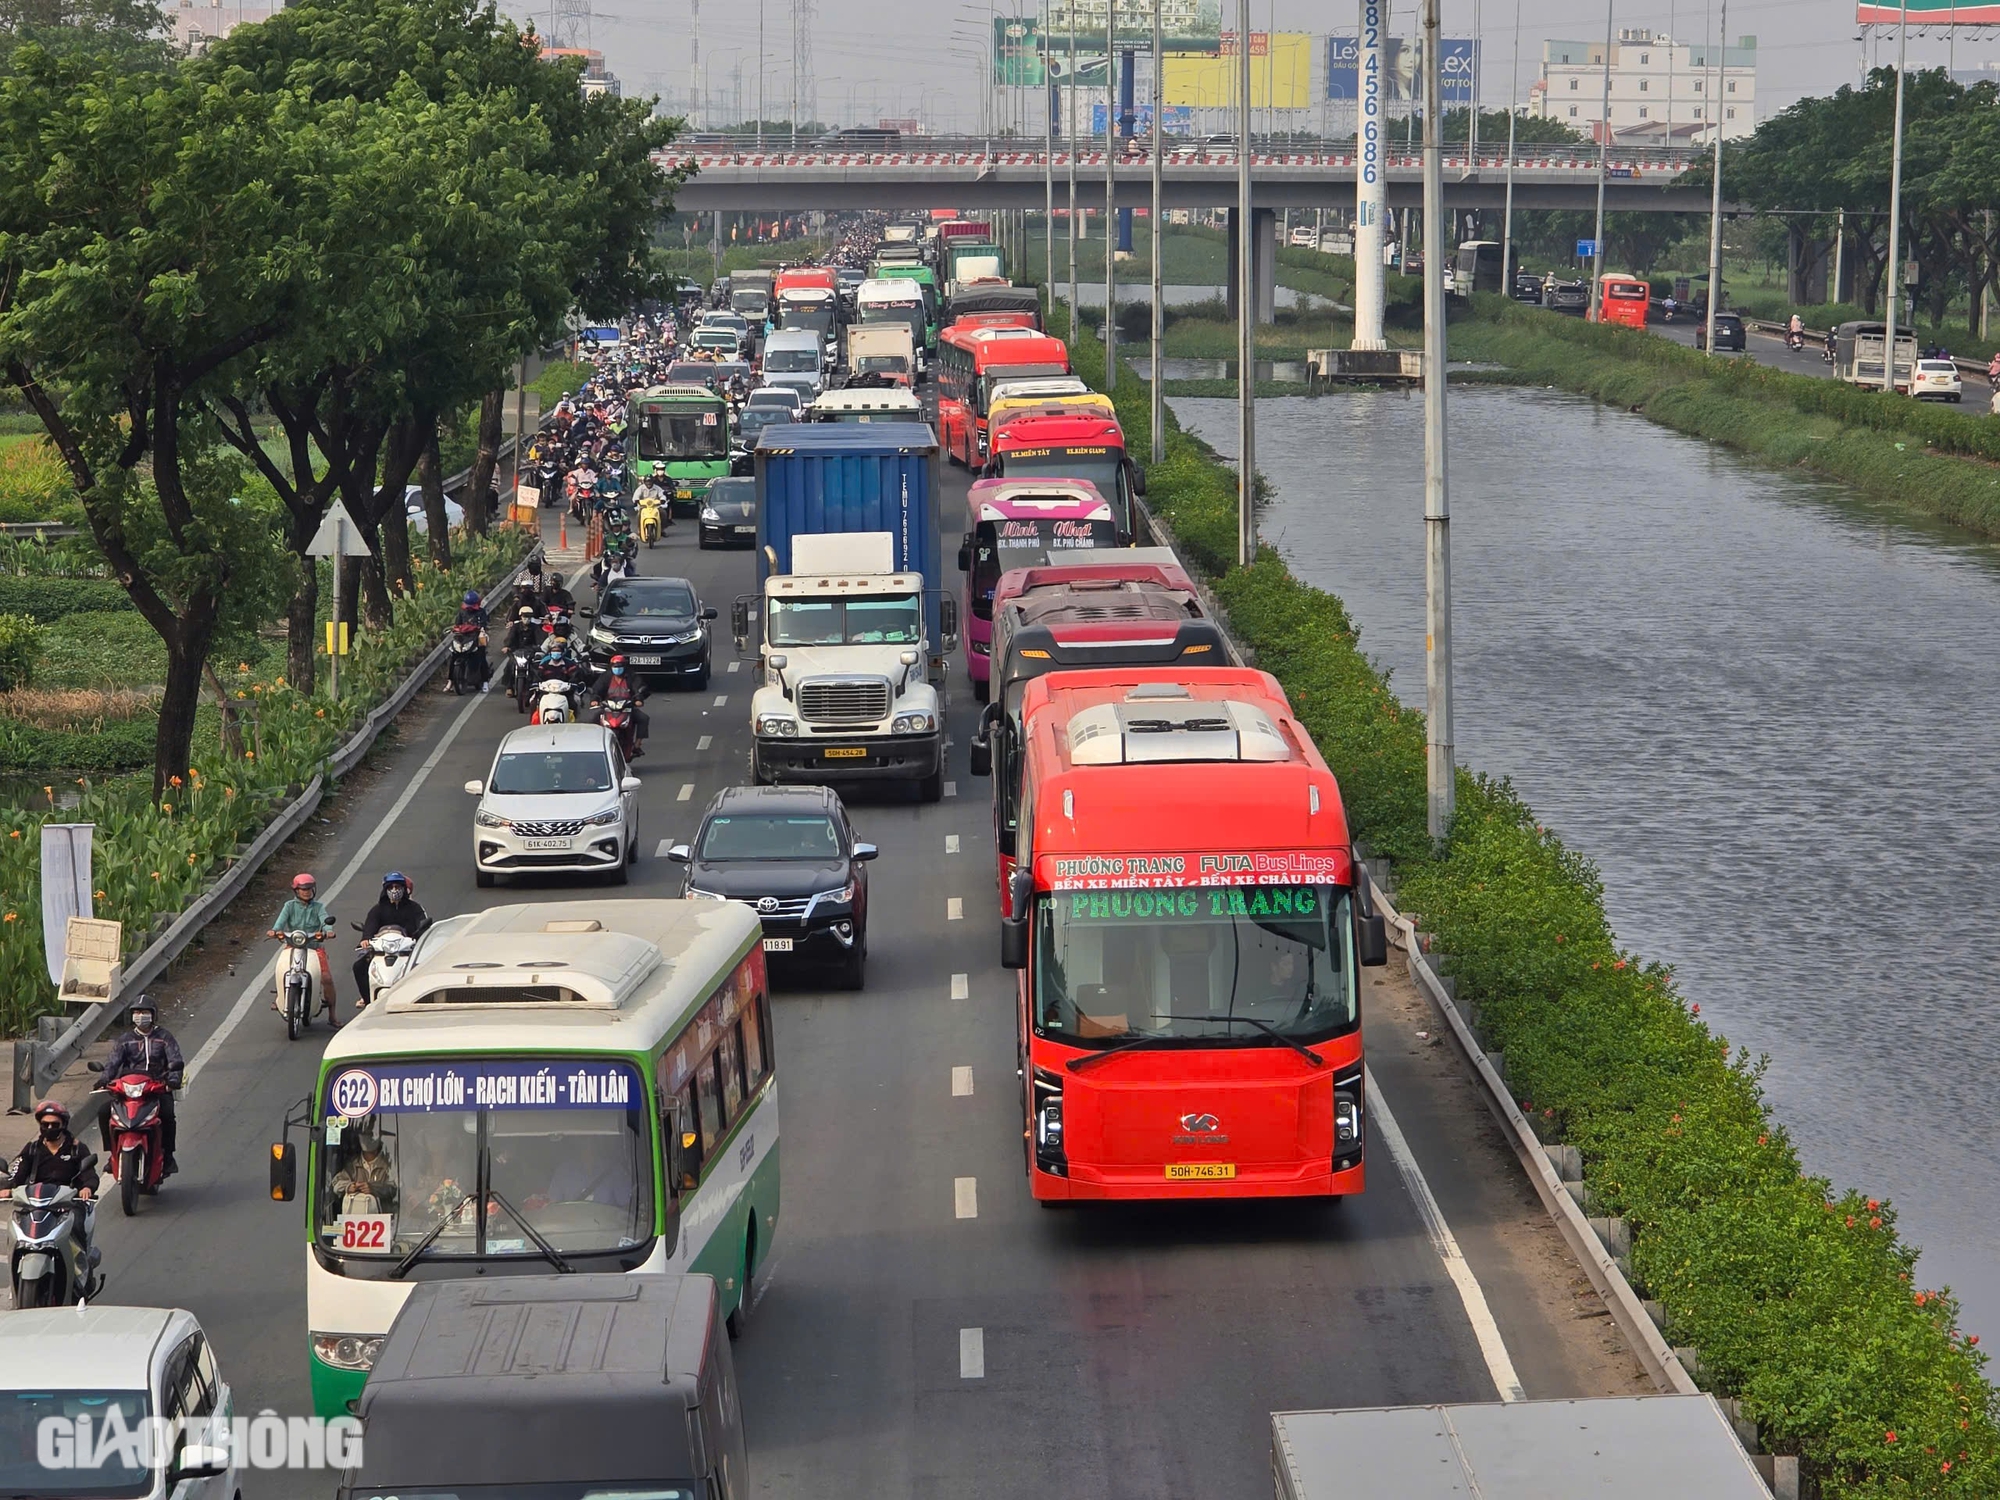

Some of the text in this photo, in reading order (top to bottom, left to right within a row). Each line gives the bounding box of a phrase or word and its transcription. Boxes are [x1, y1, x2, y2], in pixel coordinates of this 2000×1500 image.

[1441, 46, 1472, 73] éx
[1363, 0, 1380, 183] 82 456 686
[704, 414, 717, 424] 101
[998, 520, 1039, 537] Minh
[1126, 856, 1185, 875] TRANG
[1200, 854, 1254, 873] FUTA
[1054, 875, 1085, 890] BẾN
[1087, 878, 1108, 889] XE
[1110, 874, 1150, 888] MIỀN
[1152, 875, 1186, 887] TÂY
[1200, 873, 1233, 886] BẾN
[1234, 875, 1256, 885] XE
[1258, 872, 1302, 885] CHÂU
[1304, 871, 1336, 884] ĐỐC
[1206, 887, 1317, 917] TRANG
[338, 1079, 369, 1109] 622
[380, 1077, 401, 1107] BX
[402, 1072, 435, 1111] CHỢ
[436, 1070, 464, 1105] LỚN
[476, 1075, 517, 1109] RẠCH
[519, 1067, 557, 1104] KIẾN
[568, 1070, 598, 1104] TÂN
[600, 1070, 629, 1104] LÂN
[342, 1220, 385, 1248] 622
